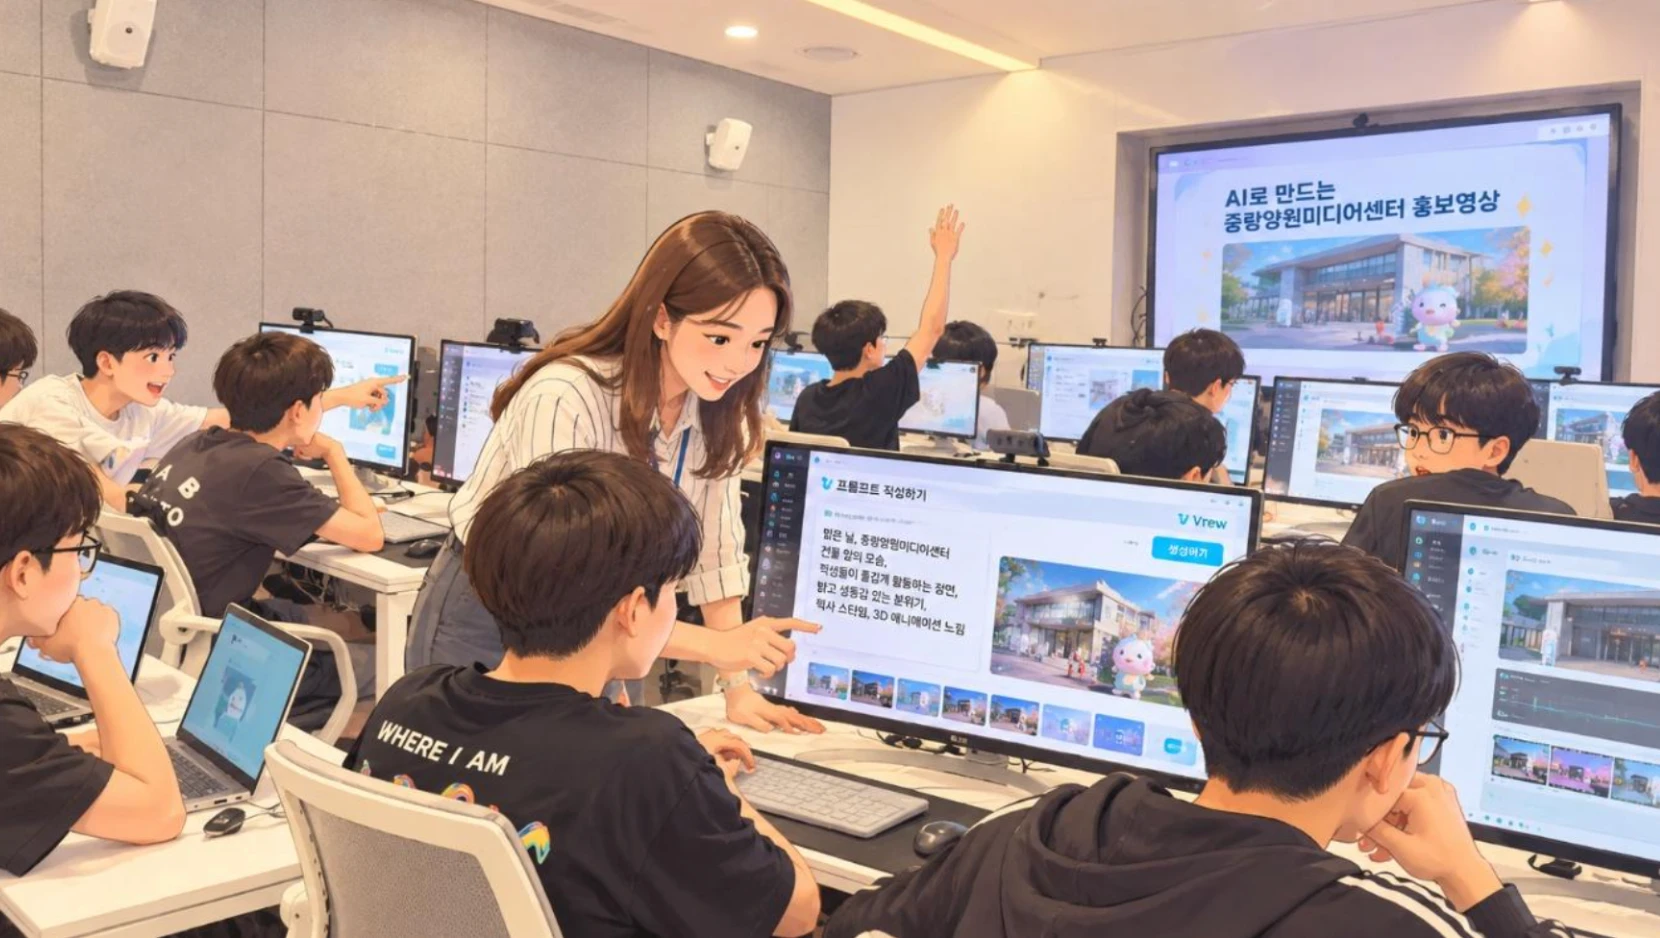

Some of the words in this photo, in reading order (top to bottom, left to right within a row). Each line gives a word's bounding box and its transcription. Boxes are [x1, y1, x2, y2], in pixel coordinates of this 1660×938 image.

[1224, 186, 1268, 208] AI로
[1275, 180, 1336, 205] 만드는
[1224, 198, 1405, 233] 중랑양원미디어센터
[1412, 189, 1501, 218] 홍보영상
[1193, 514, 1228, 530] Vrew
[871, 590, 890, 604] 있는
[872, 609, 888, 621] 3D
[377, 720, 448, 762] WHERE
[448, 747, 463, 765] I
[465, 750, 511, 776] AM
